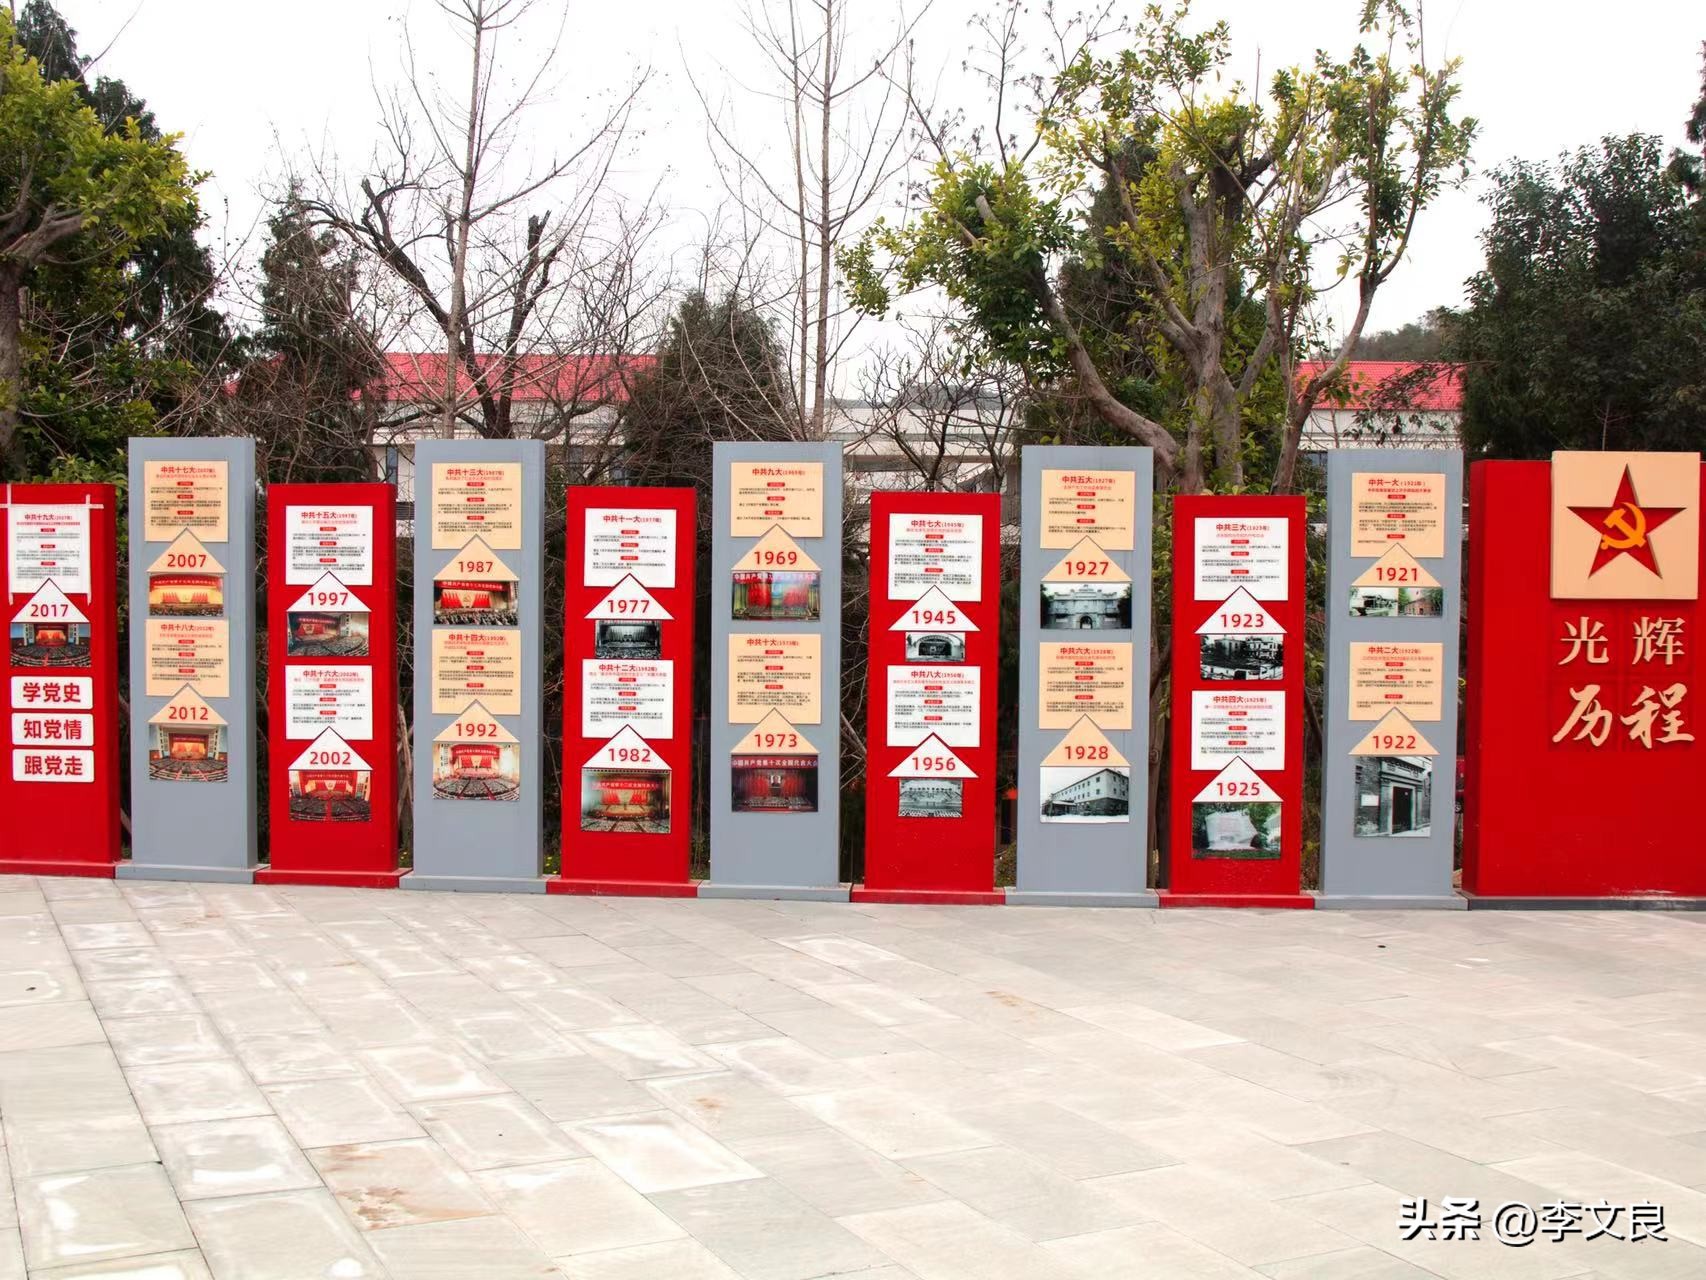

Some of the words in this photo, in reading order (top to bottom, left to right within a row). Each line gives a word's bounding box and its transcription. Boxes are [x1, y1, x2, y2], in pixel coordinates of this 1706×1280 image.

[168, 554, 206, 567] 2007
[755, 551, 797, 565] 1969
[459, 561, 493, 572] 1987
[1066, 562, 1108, 575] 1927
[1377, 568, 1417, 581] 1921
[306, 592, 348, 605] 1997
[31, 604, 68, 617] 2017
[608, 600, 649, 613] 1977
[913, 611, 955, 624] 1945
[1221, 614, 1263, 627] 1923
[1558, 616, 1686, 665] 光辉
[23, 683, 80, 702] 学党史
[169, 707, 208, 720] 2012
[1552, 682, 1695, 749] 历程
[24, 719, 81, 739] 知党情
[456, 723, 497, 737] 1992
[755, 734, 797, 747] 1973
[1373, 736, 1415, 749] 1922
[310, 752, 351, 765] 2002
[609, 747, 652, 762] 1982
[1065, 746, 1108, 759] 1928
[25, 756, 82, 775] 跟党走
[912, 756, 957, 771] 1956
[1217, 782, 1260, 796] 1925
